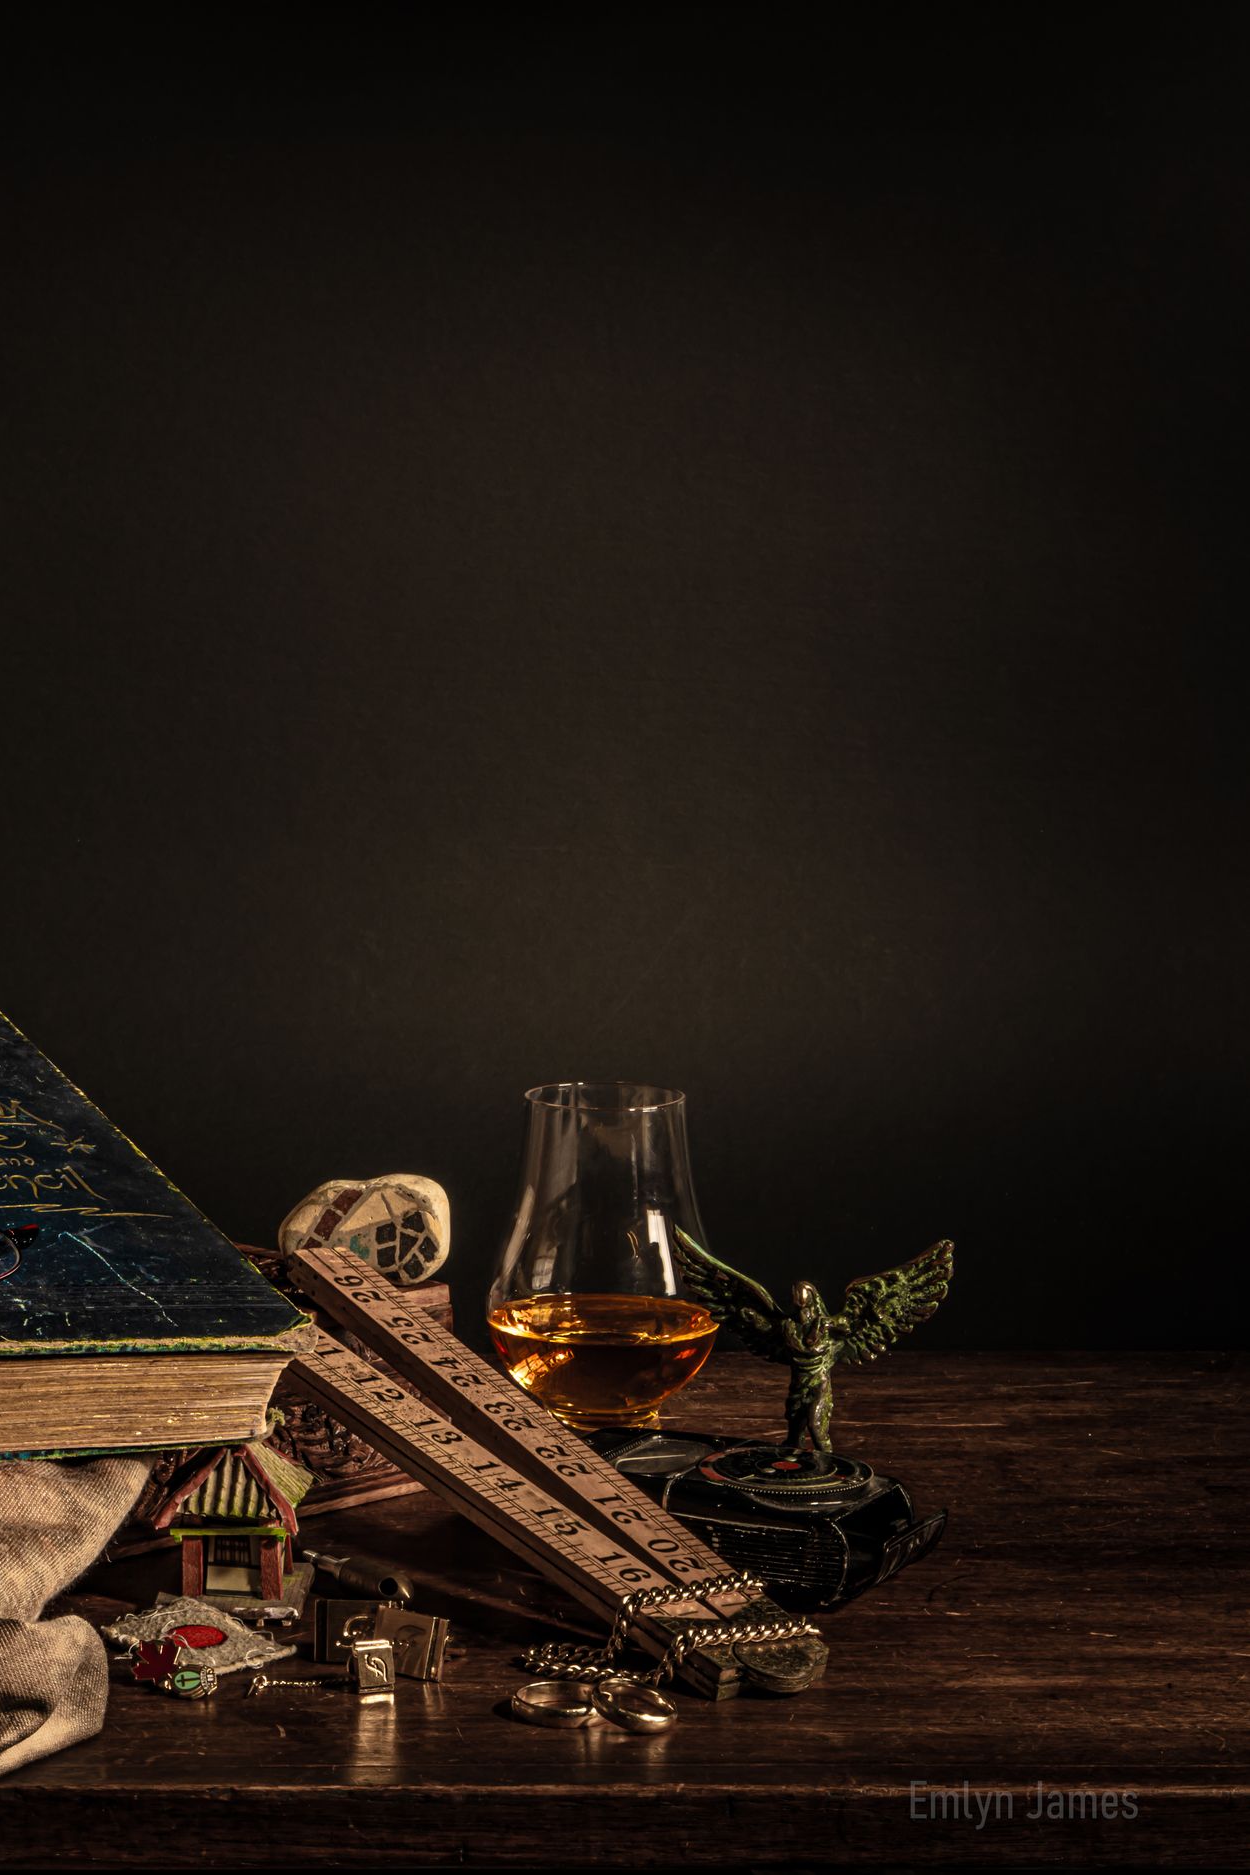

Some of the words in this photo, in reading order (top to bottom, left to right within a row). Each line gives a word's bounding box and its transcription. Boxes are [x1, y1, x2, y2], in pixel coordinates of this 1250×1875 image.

[333, 1276, 385, 1303] 26
[380, 1317, 434, 1346] 25
[429, 1356, 484, 1387] 24
[484, 1402, 537, 1432] 23
[535, 1444, 592, 1477] 22
[352, 1375, 405, 1402] 12
[409, 1417, 463, 1445] 13
[531, 1506, 590, 1536] 15
[593, 1551, 650, 1582] 16
[593, 1492, 649, 1524] 21
[648, 1539, 703, 1573] 20
